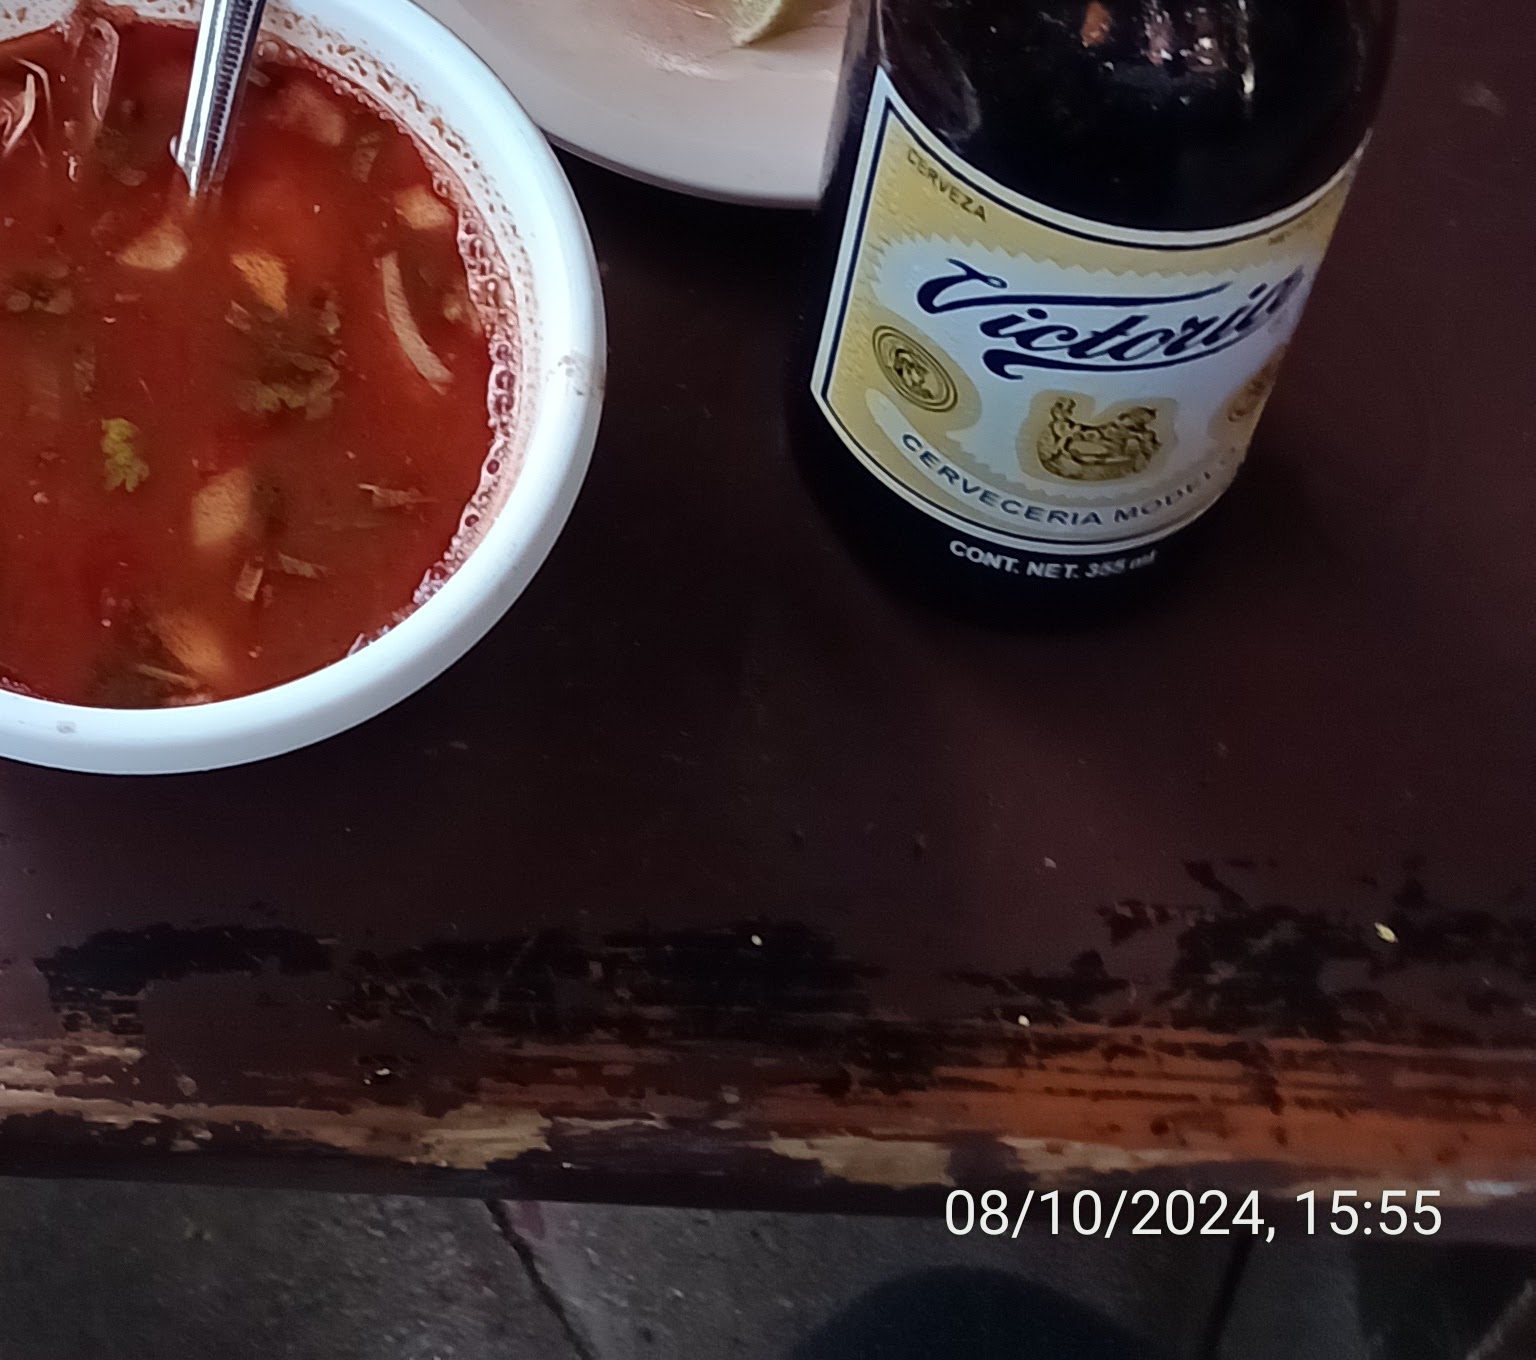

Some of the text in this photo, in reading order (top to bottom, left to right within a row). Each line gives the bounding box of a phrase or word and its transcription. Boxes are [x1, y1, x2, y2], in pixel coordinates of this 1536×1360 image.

[904, 146, 988, 223] CERVEZA
[916, 257, 1305, 381] Victoria
[902, 431, 1103, 527] CERVECERIA
[949, 538, 1019, 577] CONT.
[1025, 557, 1080, 580] NET.
